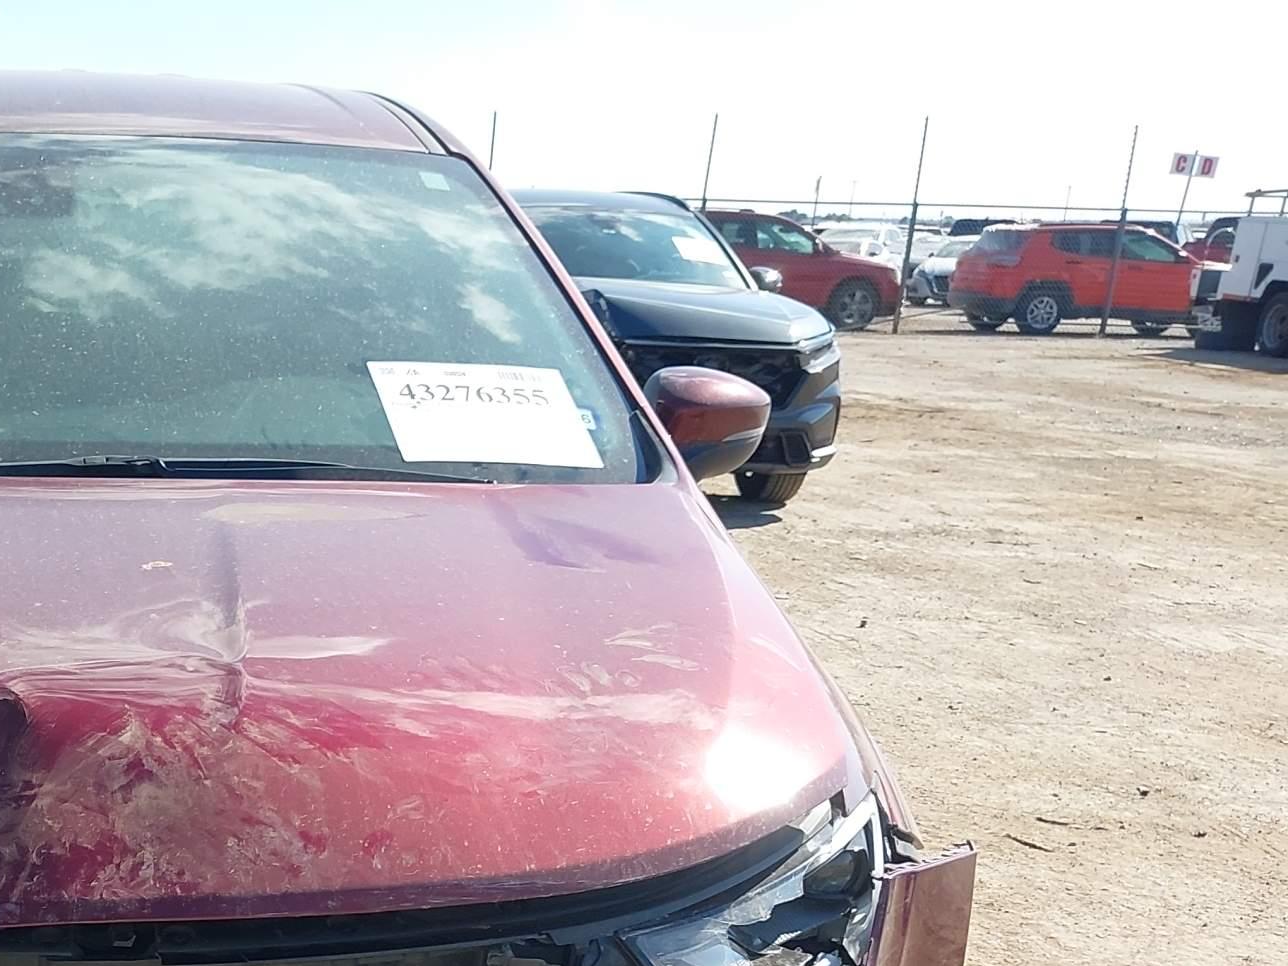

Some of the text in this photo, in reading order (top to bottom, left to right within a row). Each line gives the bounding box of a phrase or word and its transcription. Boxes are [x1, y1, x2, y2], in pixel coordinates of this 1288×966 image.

[1175, 155, 1214, 176] C D
[399, 383, 550, 406] 43276355
